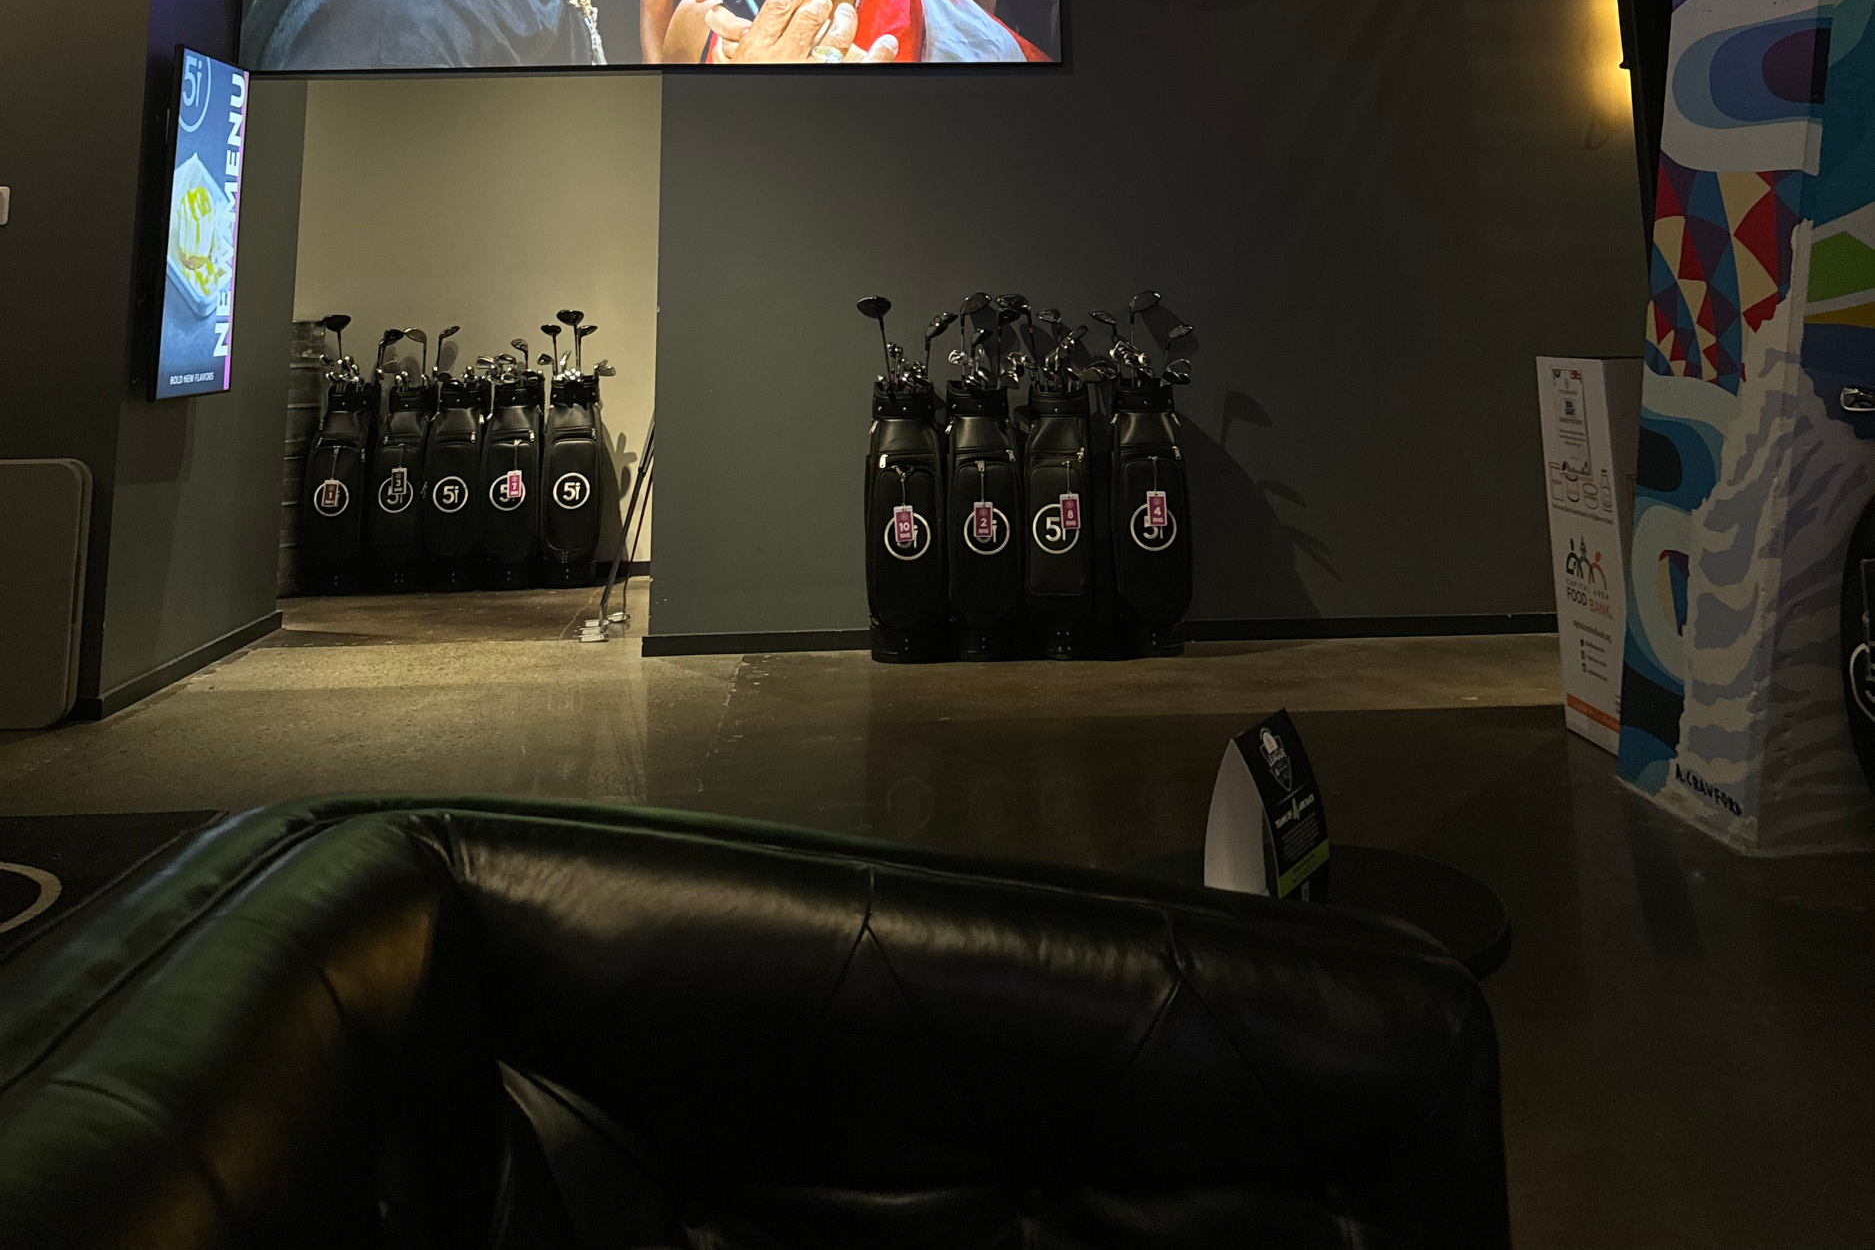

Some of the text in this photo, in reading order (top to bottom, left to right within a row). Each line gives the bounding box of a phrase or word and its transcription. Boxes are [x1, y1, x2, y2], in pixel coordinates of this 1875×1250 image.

[182, 55, 203, 108] 5i
[212, 73, 247, 357] NEW MENU
[169, 372, 214, 386] BOLD NEW FLAVORS
[442, 485, 460, 504] 5i
[562, 482, 581, 501] 5i
[1067, 510, 1074, 519] 8
[1153, 507, 1162, 516] 4
[898, 522, 910, 531] 10
[980, 518, 987, 527] 2
[1567, 586, 1587, 606] FOOD
[1593, 589, 1609, 600] AREA
